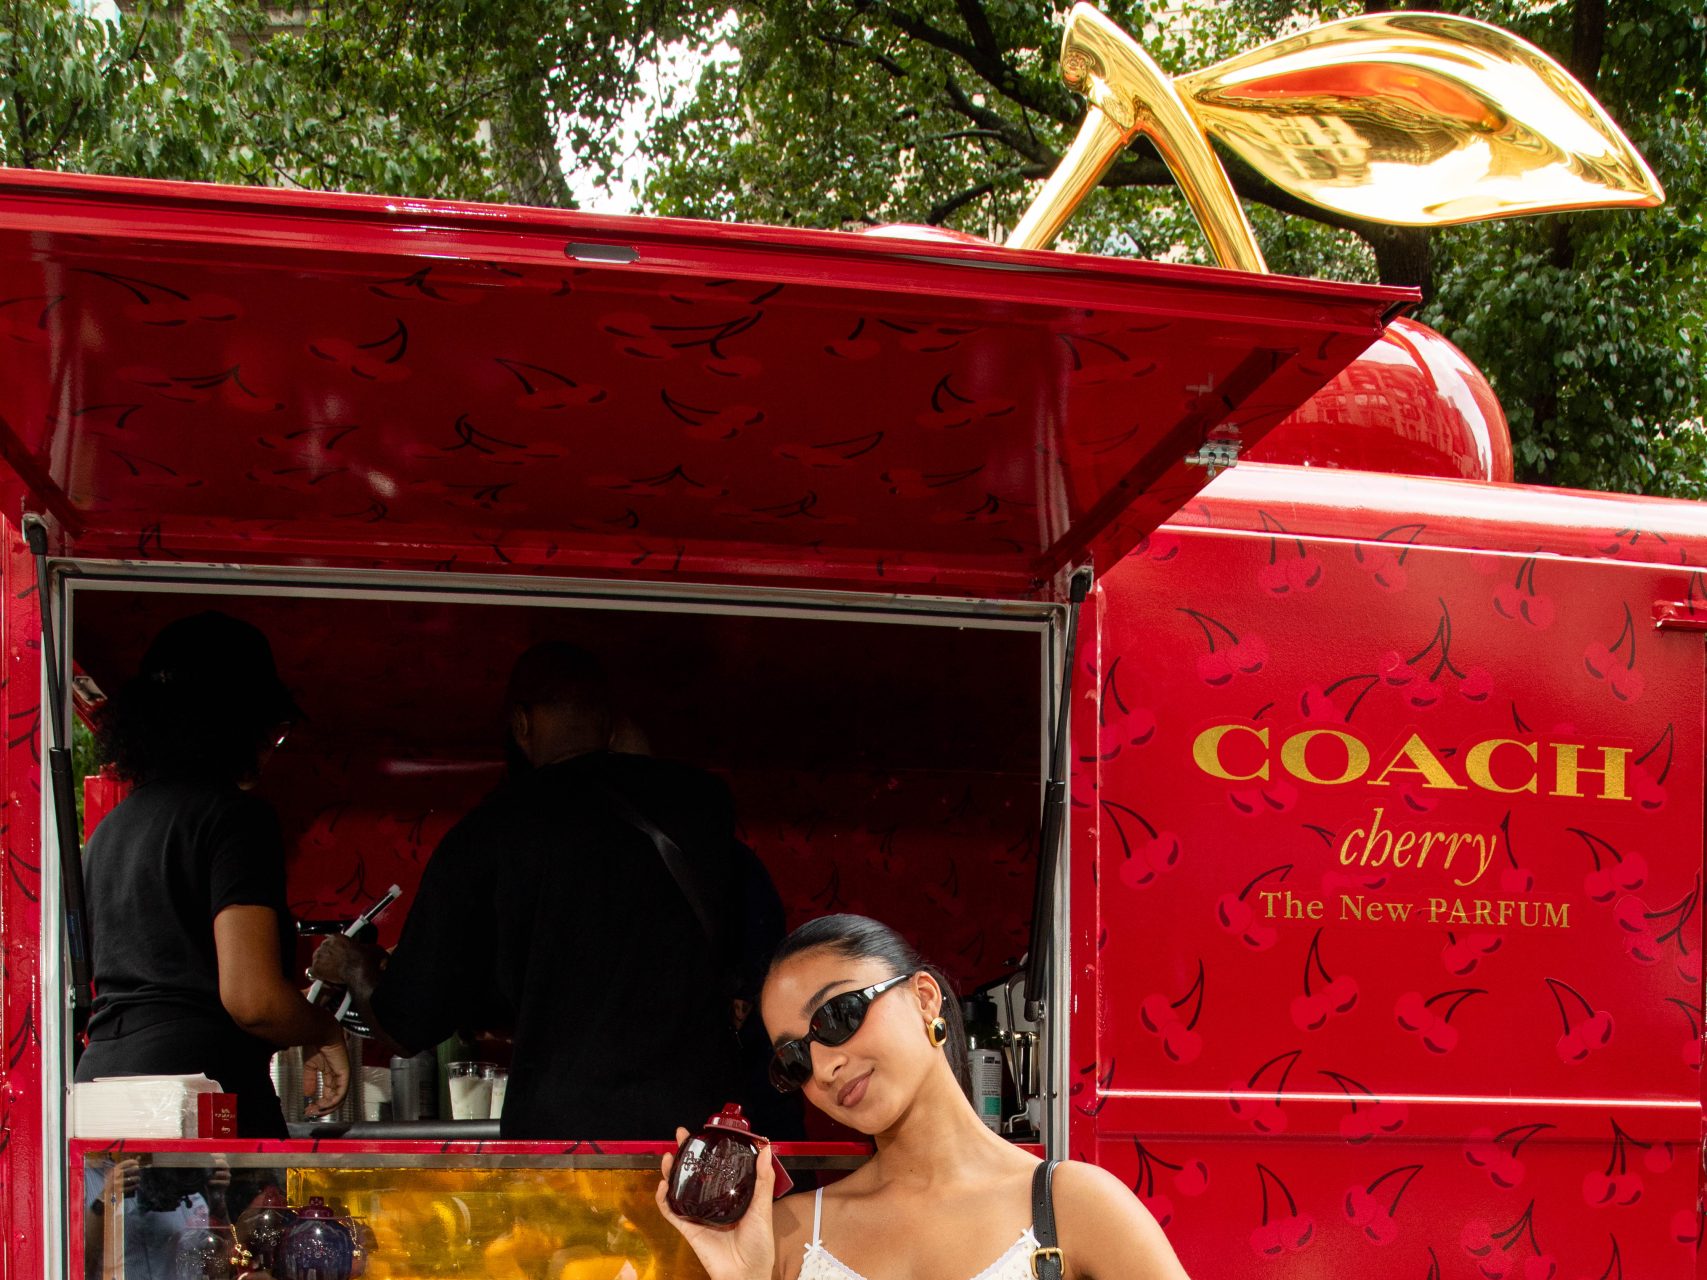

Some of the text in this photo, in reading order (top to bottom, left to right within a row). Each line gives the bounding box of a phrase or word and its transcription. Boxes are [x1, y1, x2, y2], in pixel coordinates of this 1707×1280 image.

[1192, 724, 1633, 800] COACH
[1340, 807, 1497, 886] cherry
[1259, 890, 1570, 928] The New PARFUM
